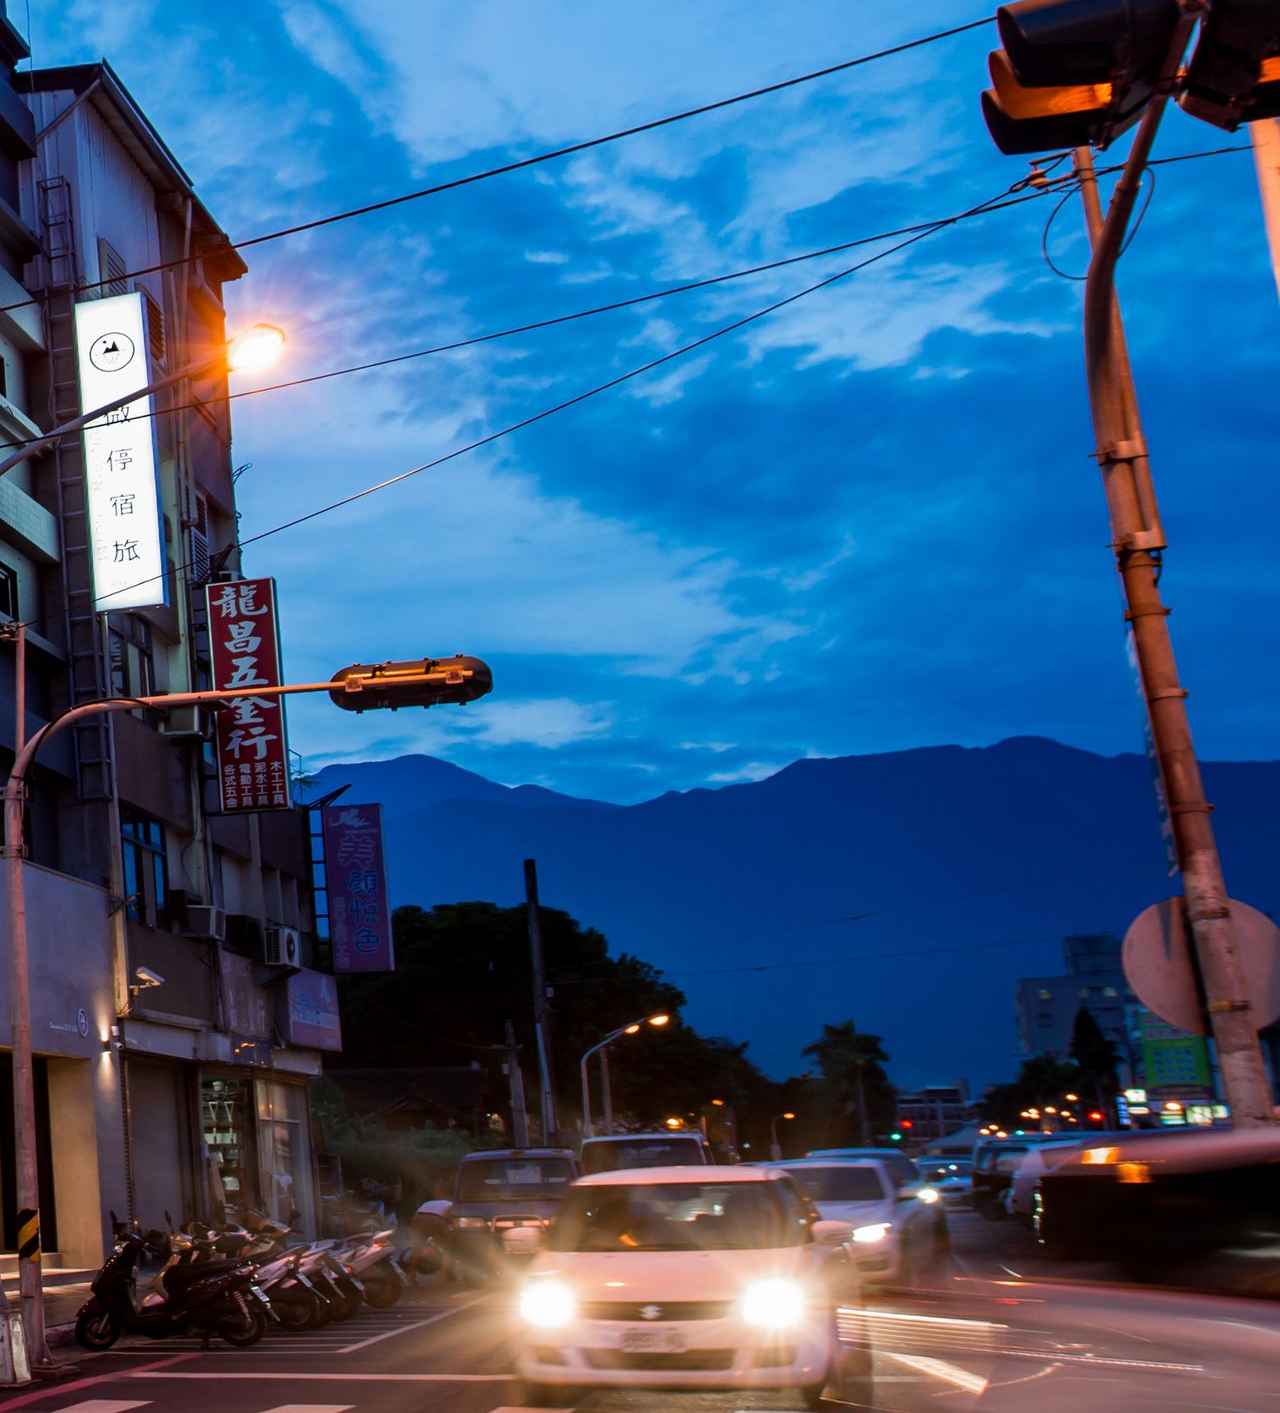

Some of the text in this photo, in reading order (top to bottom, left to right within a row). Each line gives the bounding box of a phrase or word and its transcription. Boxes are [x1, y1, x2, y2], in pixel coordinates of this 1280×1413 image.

[211, 584, 279, 761] 龍昌五金行
